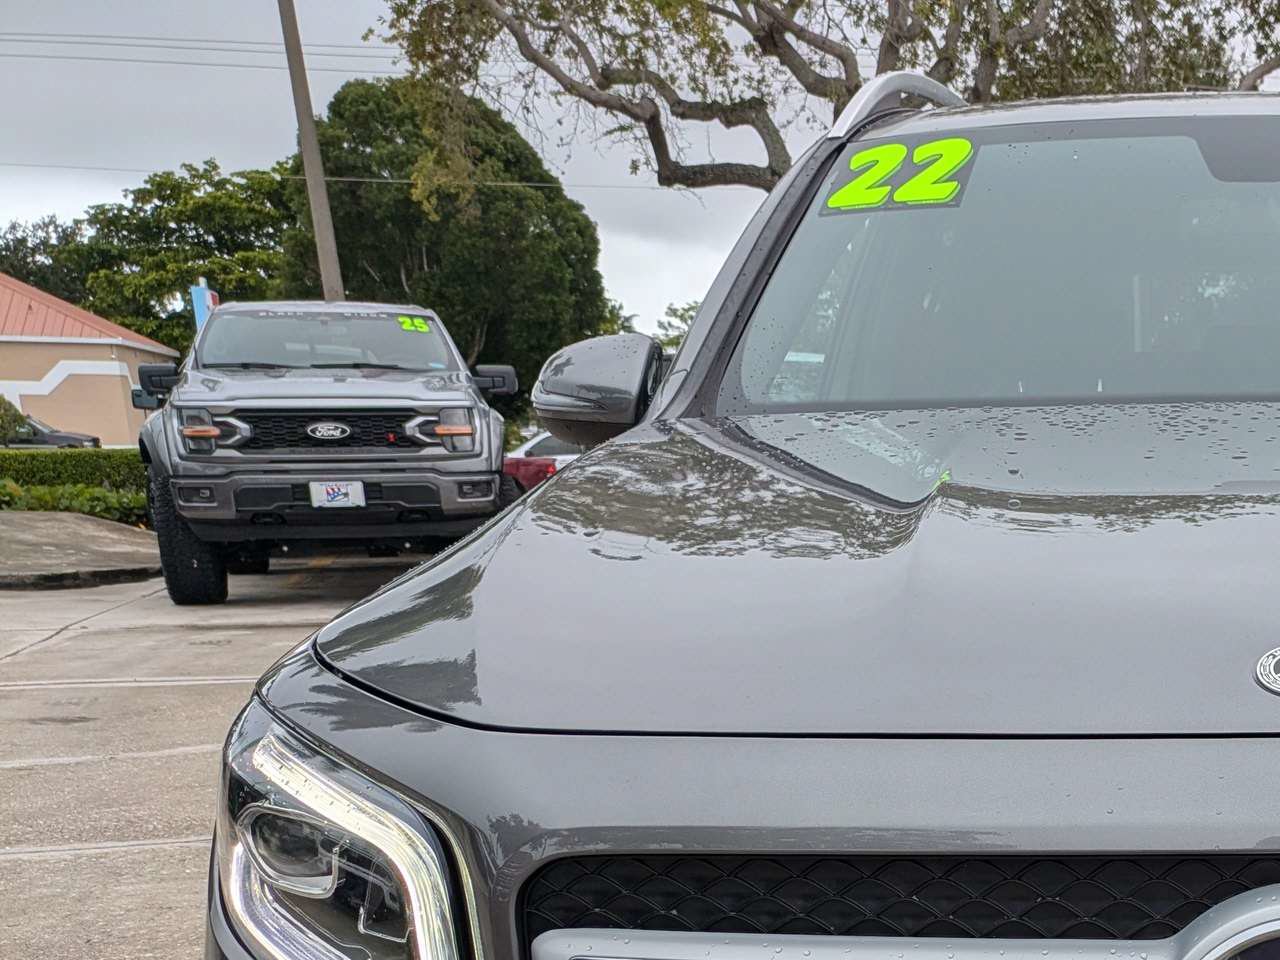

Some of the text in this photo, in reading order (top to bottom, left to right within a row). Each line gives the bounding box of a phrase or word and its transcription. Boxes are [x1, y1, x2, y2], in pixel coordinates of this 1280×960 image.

[827, 138, 973, 210] 22
[398, 315, 430, 333] 25
[315, 425, 342, 437] Ford
